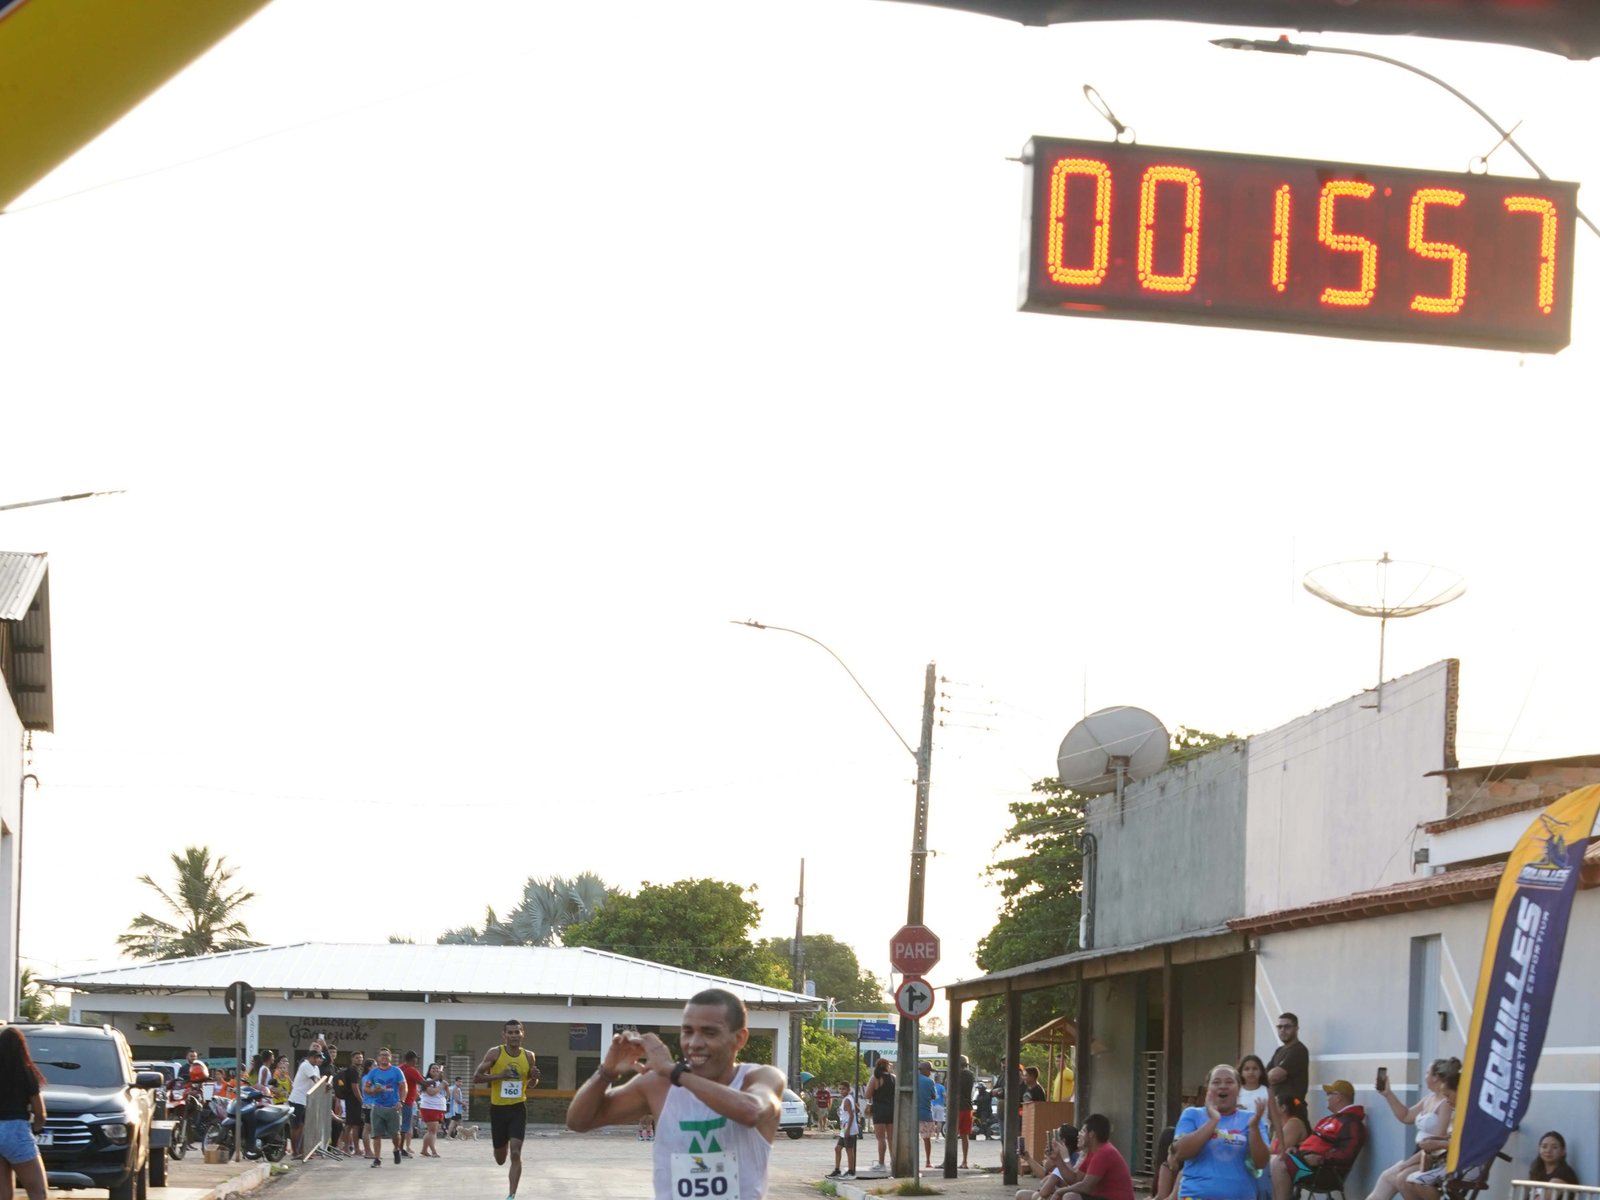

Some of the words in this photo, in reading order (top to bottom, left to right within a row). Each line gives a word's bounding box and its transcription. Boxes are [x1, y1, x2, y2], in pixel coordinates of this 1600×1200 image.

[895, 942, 935, 959] PARE
[1479, 896, 1542, 1122] AQUILLES
[678, 1176, 728, 1197] 050
